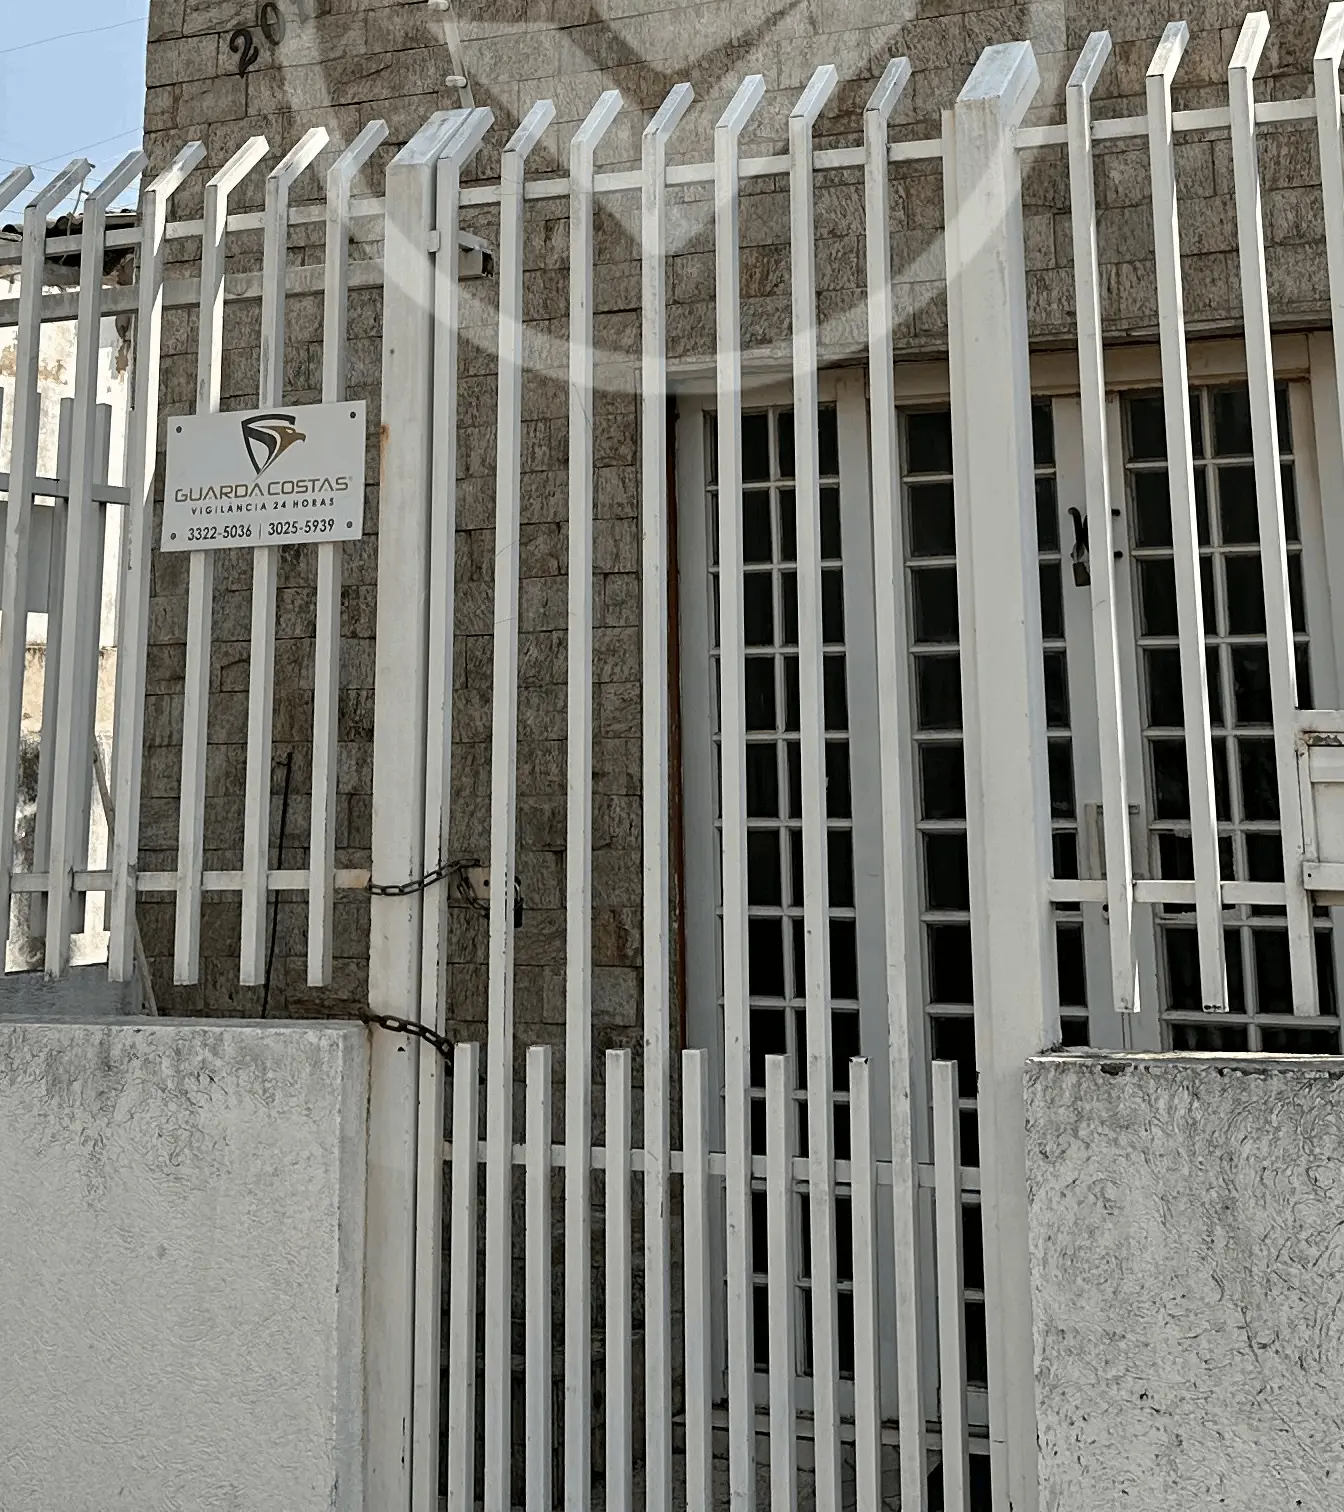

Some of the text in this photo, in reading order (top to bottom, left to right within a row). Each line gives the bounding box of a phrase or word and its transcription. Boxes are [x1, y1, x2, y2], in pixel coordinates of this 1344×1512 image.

[175, 477, 349, 502] GUARDACOSTAS
[273, 500, 287, 510] 24
[293, 498, 335, 508] HORAS
[188, 518, 335, 541] 3322-5036 3025-5939
